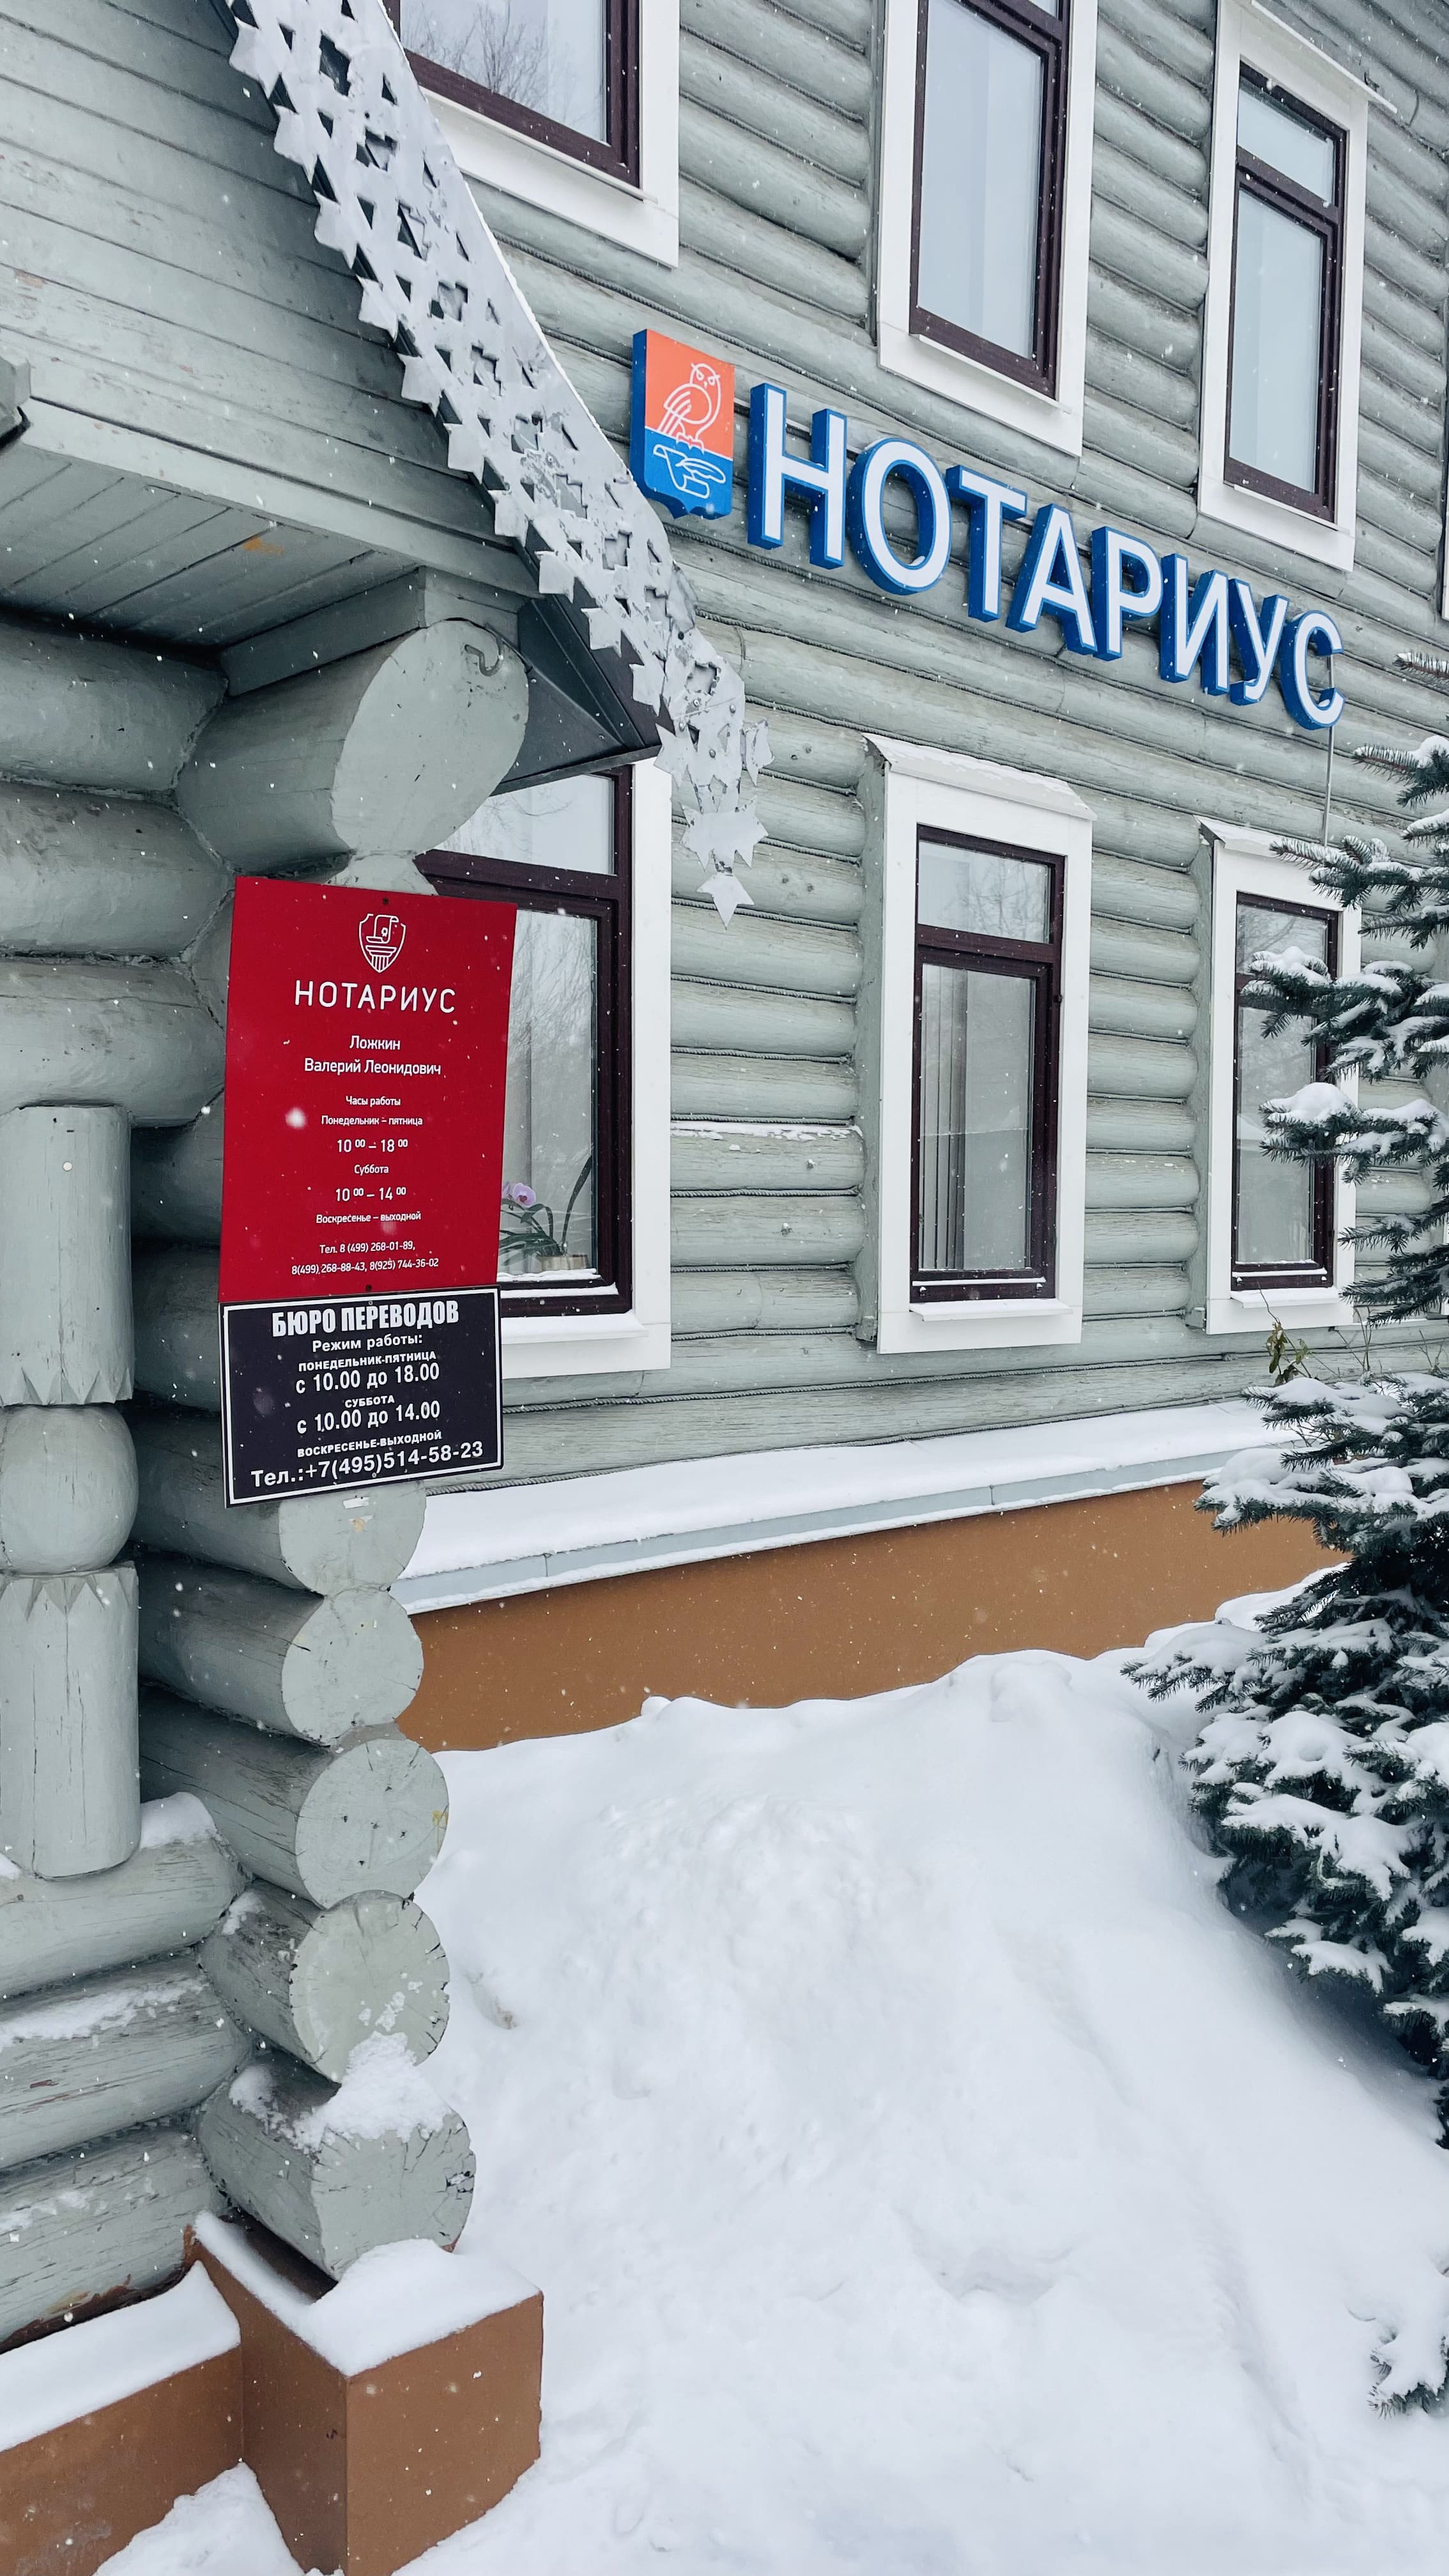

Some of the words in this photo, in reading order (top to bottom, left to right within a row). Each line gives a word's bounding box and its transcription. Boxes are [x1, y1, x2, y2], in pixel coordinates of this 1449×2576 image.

[747, 383, 1345, 730] НОТАРИУС
[295, 979, 456, 1013] НОТАРИУС
[349, 1035, 401, 1050] Ложкин
[304, 1057, 362, 1075] Валерий
[364, 1060, 441, 1076] Леонидович
[346, 1096, 368, 1106] Часы
[370, 1096, 401, 1107] работы
[321, 1115, 379, 1126] Понедельник
[388, 1117, 423, 1126] пятница
[337, 1139, 351, 1153] 10
[355, 1138, 365, 1148] 00
[380, 1138, 395, 1153] 18
[397, 1138, 408, 1148] 00
[354, 1164, 389, 1176] Суббота
[335, 1188, 350, 1202] 10
[353, 1188, 364, 1197] 00
[379, 1187, 394, 1200] 14
[396, 1186, 406, 1196] 00
[316, 1213, 371, 1224] Воскресенье
[380, 1211, 421, 1222] выходной
[319, 1244, 338, 1254] Тел.
[339, 1243, 346, 1253] 8
[347, 1242, 369, 1254] (499)
[371, 1241, 416, 1252] 268-01-89,
[321, 1262, 367, 1273] 268-88-43,
[369, 1260, 395, 1271] 8(925)
[397, 1257, 439, 1269] 744-36-02
[272, 1308, 337, 1337] БЮРО
[341, 1300, 459, 1331] ПЕРЕВОДОВ
[312, 1338, 362, 1353] Режим
[367, 1333, 423, 1350] работы:
[298, 1351, 436, 1372] ПОНЕДЕЛЬНИК-ПЯТНИЦА
[314, 1370, 360, 1392] 10.00
[367, 1371, 388, 1390] до
[395, 1363, 440, 1383] 18.00
[344, 1395, 395, 1408] СУББОТА
[315, 1409, 362, 1431] 10.00
[367, 1409, 388, 1428] до
[396, 1400, 440, 1422] 14.00
[297, 1430, 442, 1458] ВОСКРЕСЕНЬЕ-ВЫХОДНОЙ
